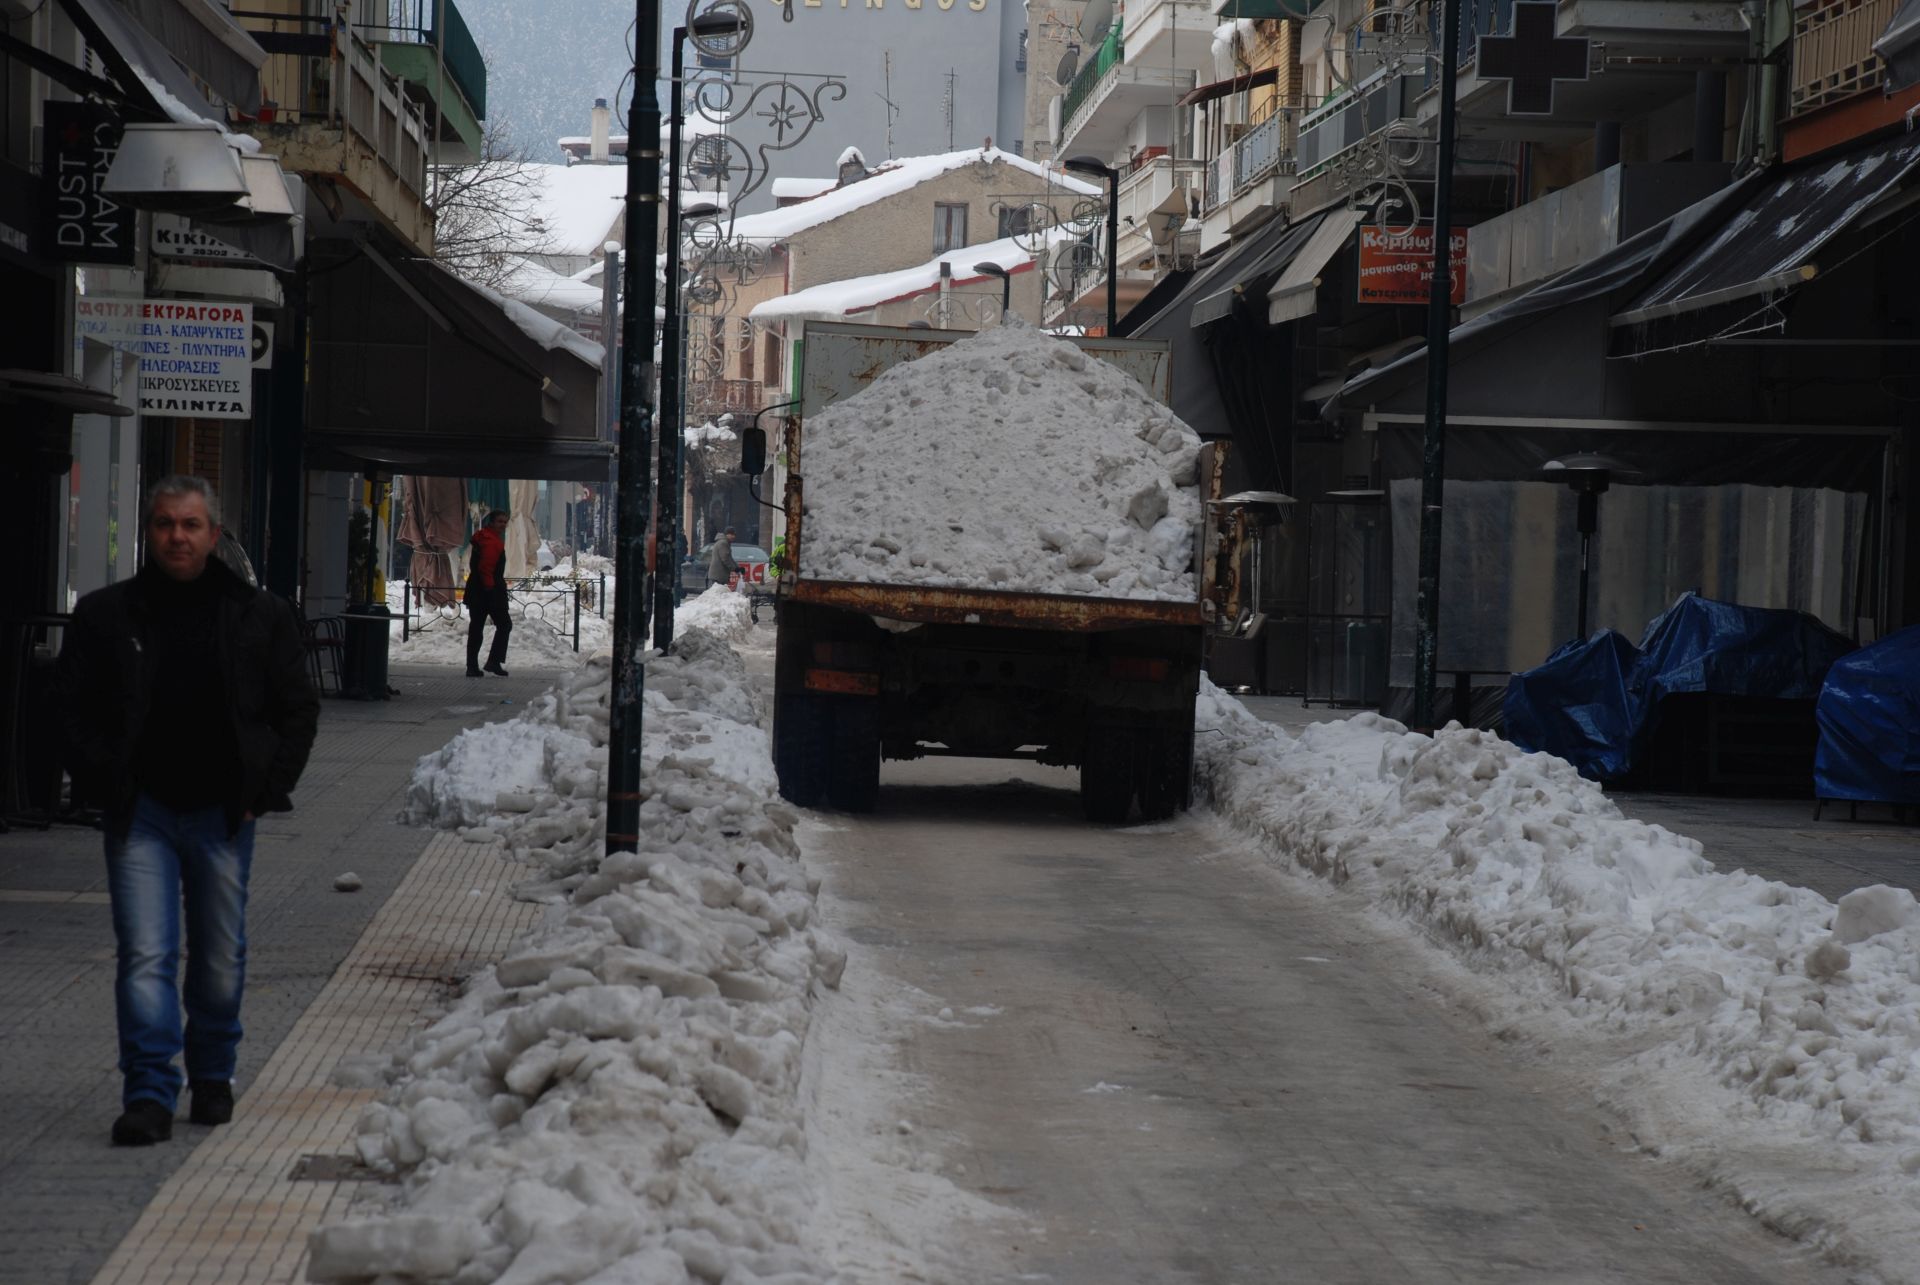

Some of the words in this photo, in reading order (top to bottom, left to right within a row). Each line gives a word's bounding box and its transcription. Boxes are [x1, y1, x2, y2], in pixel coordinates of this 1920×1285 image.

[57, 152, 87, 246] DUST
[171, 324, 245, 340] ΚΑΤΑΨΥΚΤΕΣ
[182, 342, 246, 358] ΠΛΥΝΤΗΡΙΑ
[141, 398, 244, 413] ΚΙΛΙΝΤΖΑ
